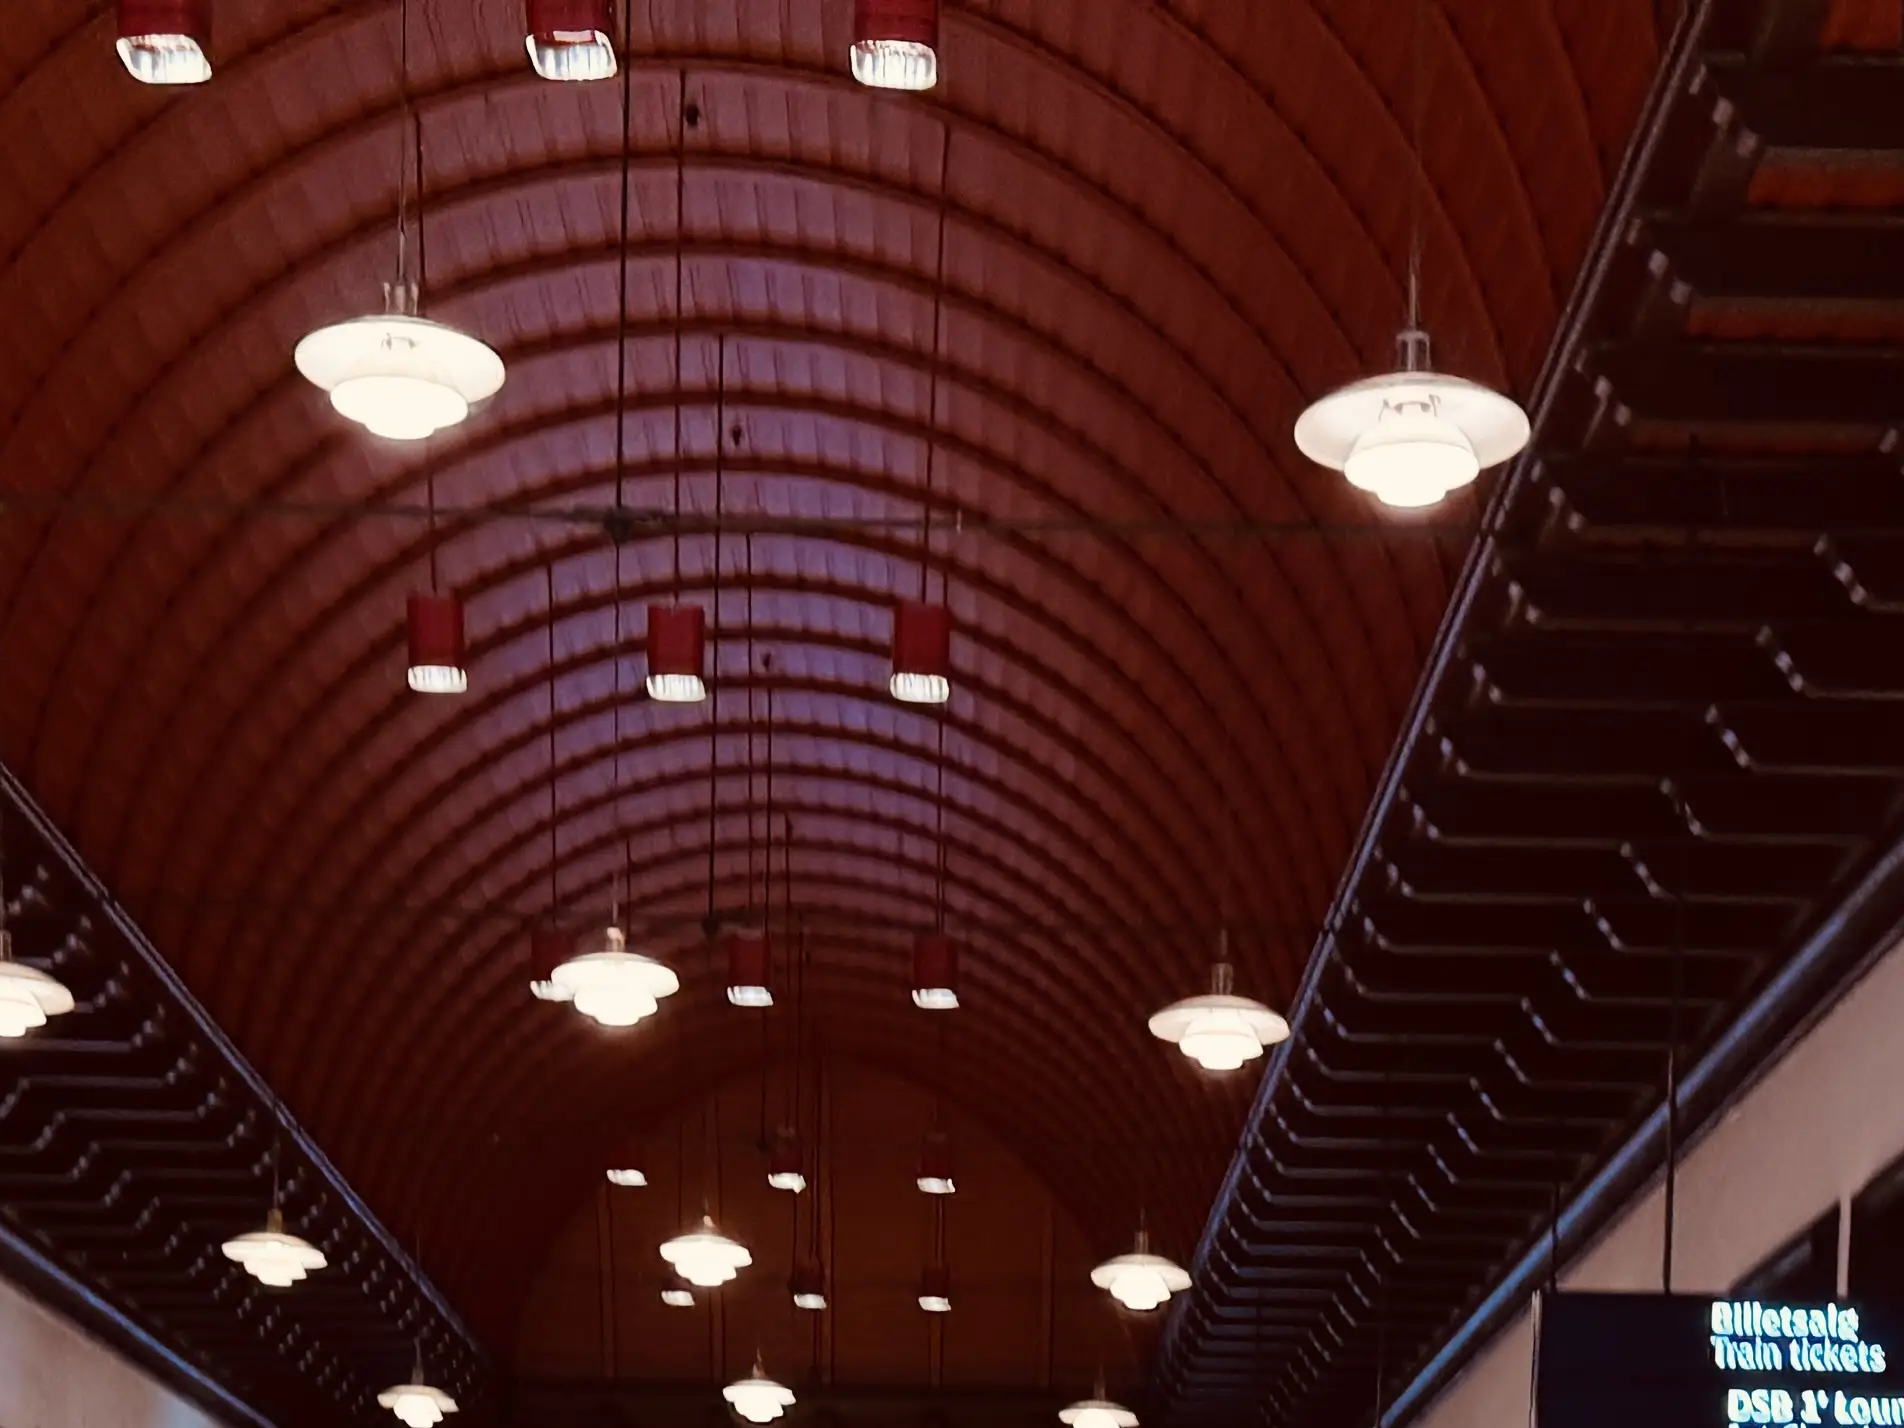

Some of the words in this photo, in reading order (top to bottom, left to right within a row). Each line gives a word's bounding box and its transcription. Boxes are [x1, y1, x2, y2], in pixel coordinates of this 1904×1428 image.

[1711, 1301, 1859, 1342] Billetsalg
[1710, 1335, 1783, 1371] Train
[1790, 1338, 1886, 1373] tickets
[1727, 1388, 1793, 1424] DSB
